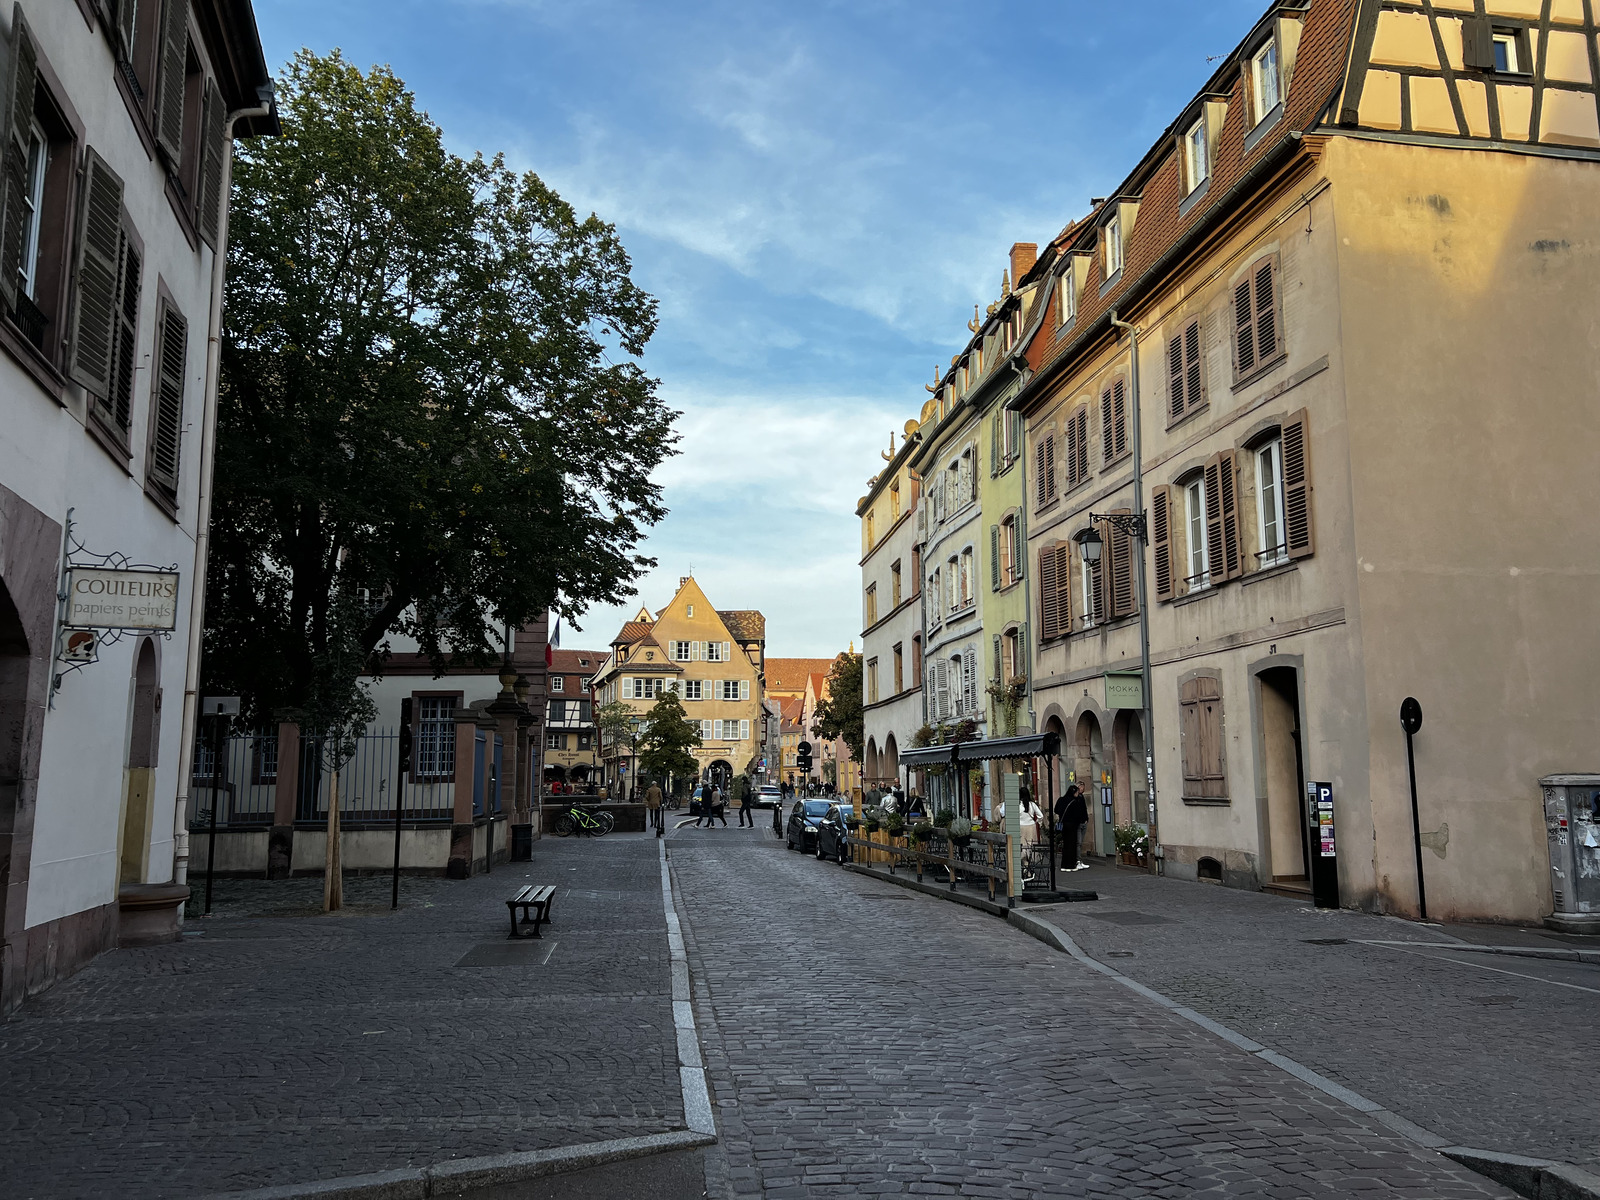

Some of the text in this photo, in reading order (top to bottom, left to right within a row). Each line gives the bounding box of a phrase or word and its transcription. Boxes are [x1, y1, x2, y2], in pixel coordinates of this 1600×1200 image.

[75, 578, 174, 598] COULEURS
[73, 599, 171, 621] papiers peints
[1108, 685, 1140, 693] MOKKA
[1320, 788, 1330, 801] P
